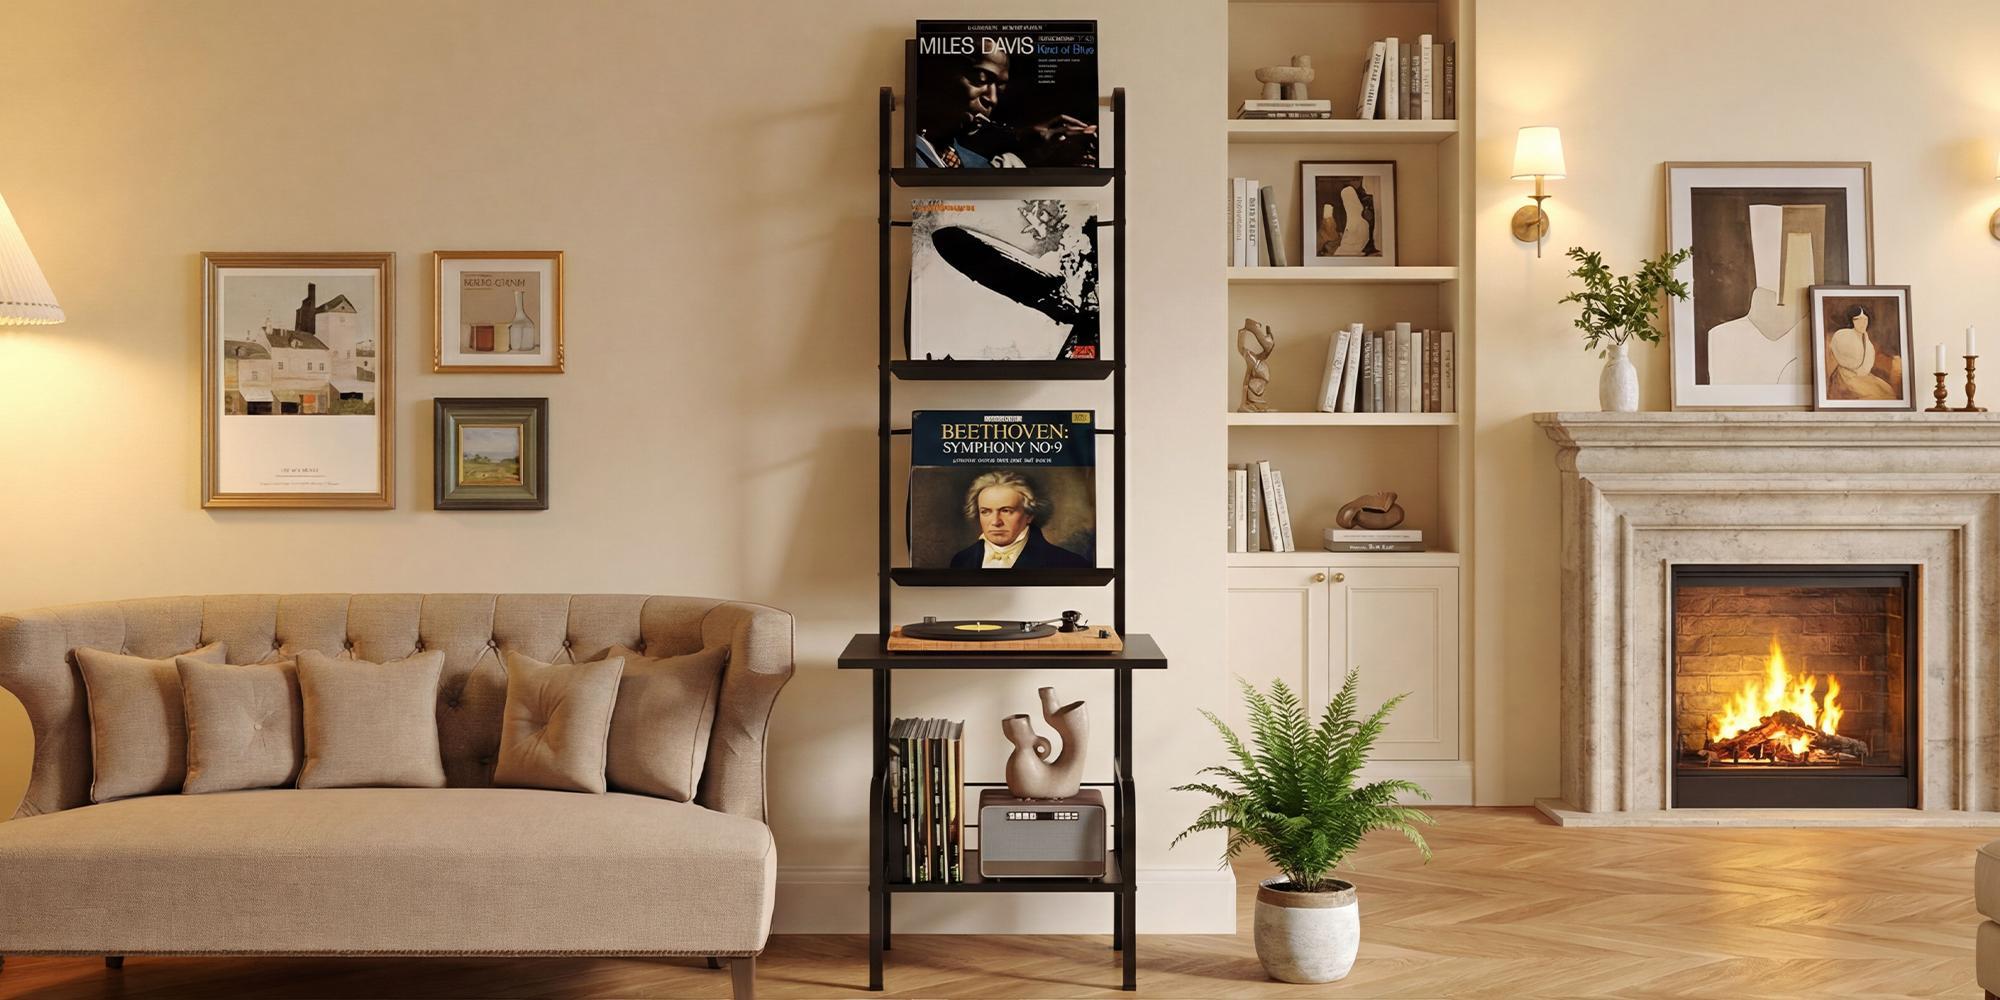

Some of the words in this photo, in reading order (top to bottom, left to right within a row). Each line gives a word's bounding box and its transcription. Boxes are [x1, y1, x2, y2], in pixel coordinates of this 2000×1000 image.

[919, 36, 975, 55] MILES
[981, 36, 1034, 55] DAVIS
[1037, 43, 1058, 55] Kind
[1060, 44, 1070, 55] of
[1072, 43, 1095, 55] Blue
[941, 423, 1069, 440] BEETHOVEN:
[943, 441, 1028, 454] SYMPHONY
